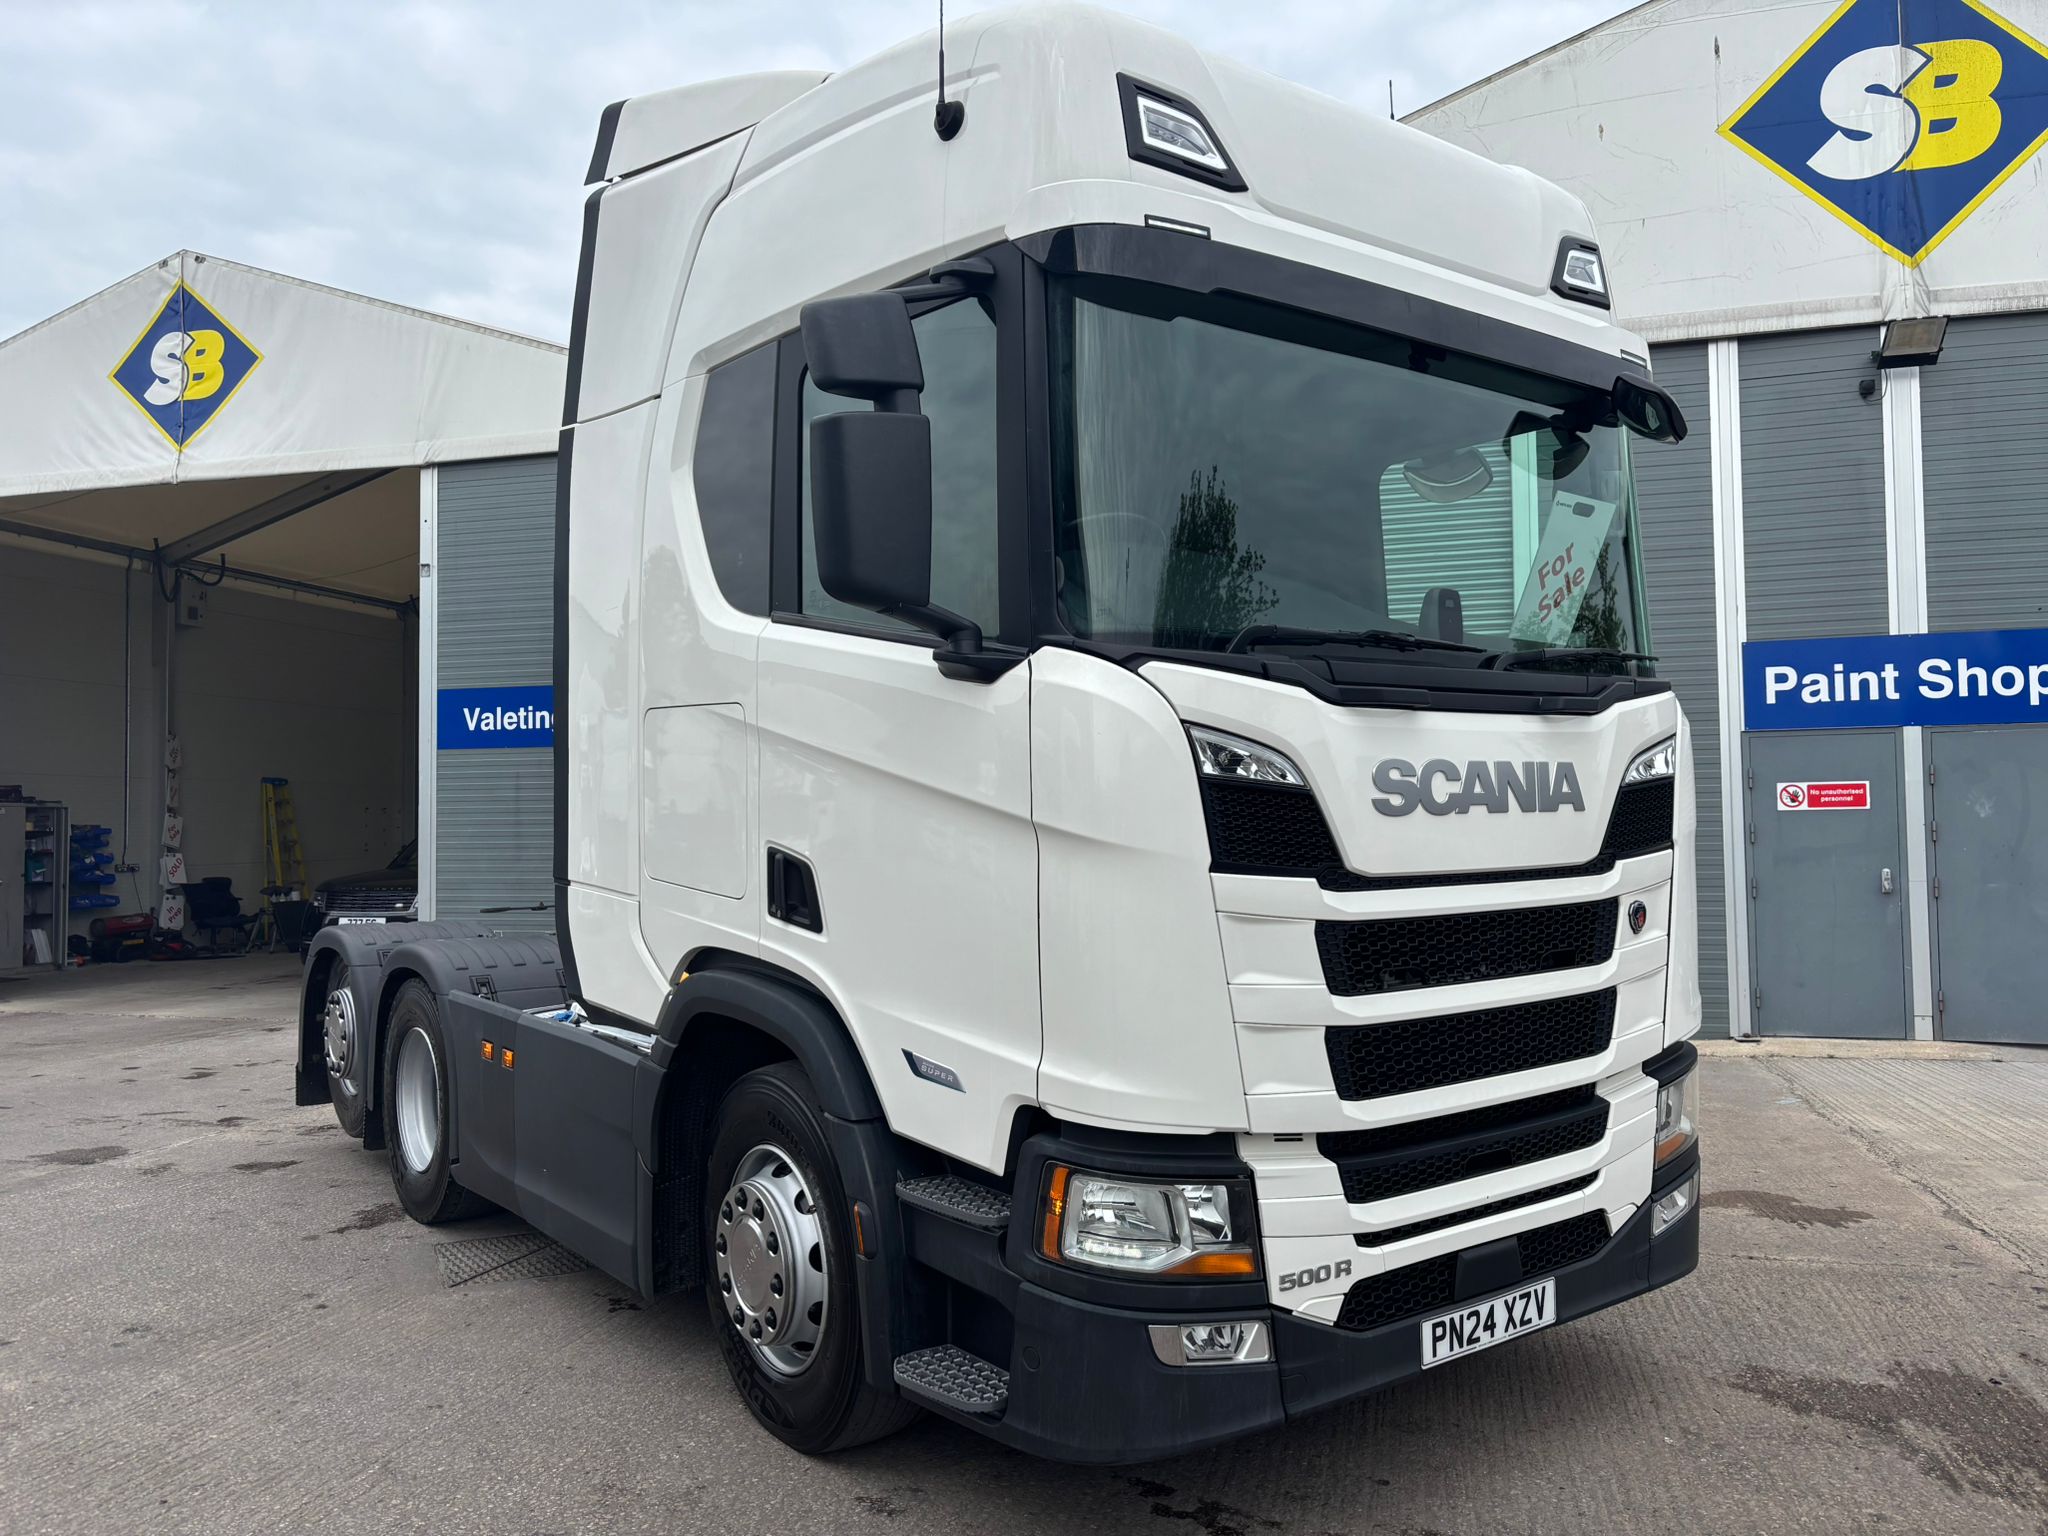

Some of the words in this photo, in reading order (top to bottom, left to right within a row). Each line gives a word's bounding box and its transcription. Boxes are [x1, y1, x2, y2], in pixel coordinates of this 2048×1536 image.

[1806, 38, 2003, 181] SB
[143, 329, 225, 406] SB
[1537, 542, 1574, 591] For
[1538, 566, 1585, 623] Sale
[1765, 663, 1900, 705] Paint
[1918, 658, 2048, 706] Shop
[462, 705, 554, 733] Valetin
[1371, 758, 1586, 817] SCANIA
[1820, 795, 1853, 803] personnel
[168, 857, 183, 878] SOLD
[166, 905, 175, 915] In
[168, 907, 183, 924] Prep
[921, 1064, 953, 1082] SUPER
[1279, 1264, 1331, 1292] 500
[1334, 1259, 1352, 1279] R
[1432, 1304, 1496, 1358] PN24
[1504, 1286, 1546, 1333] XZV
